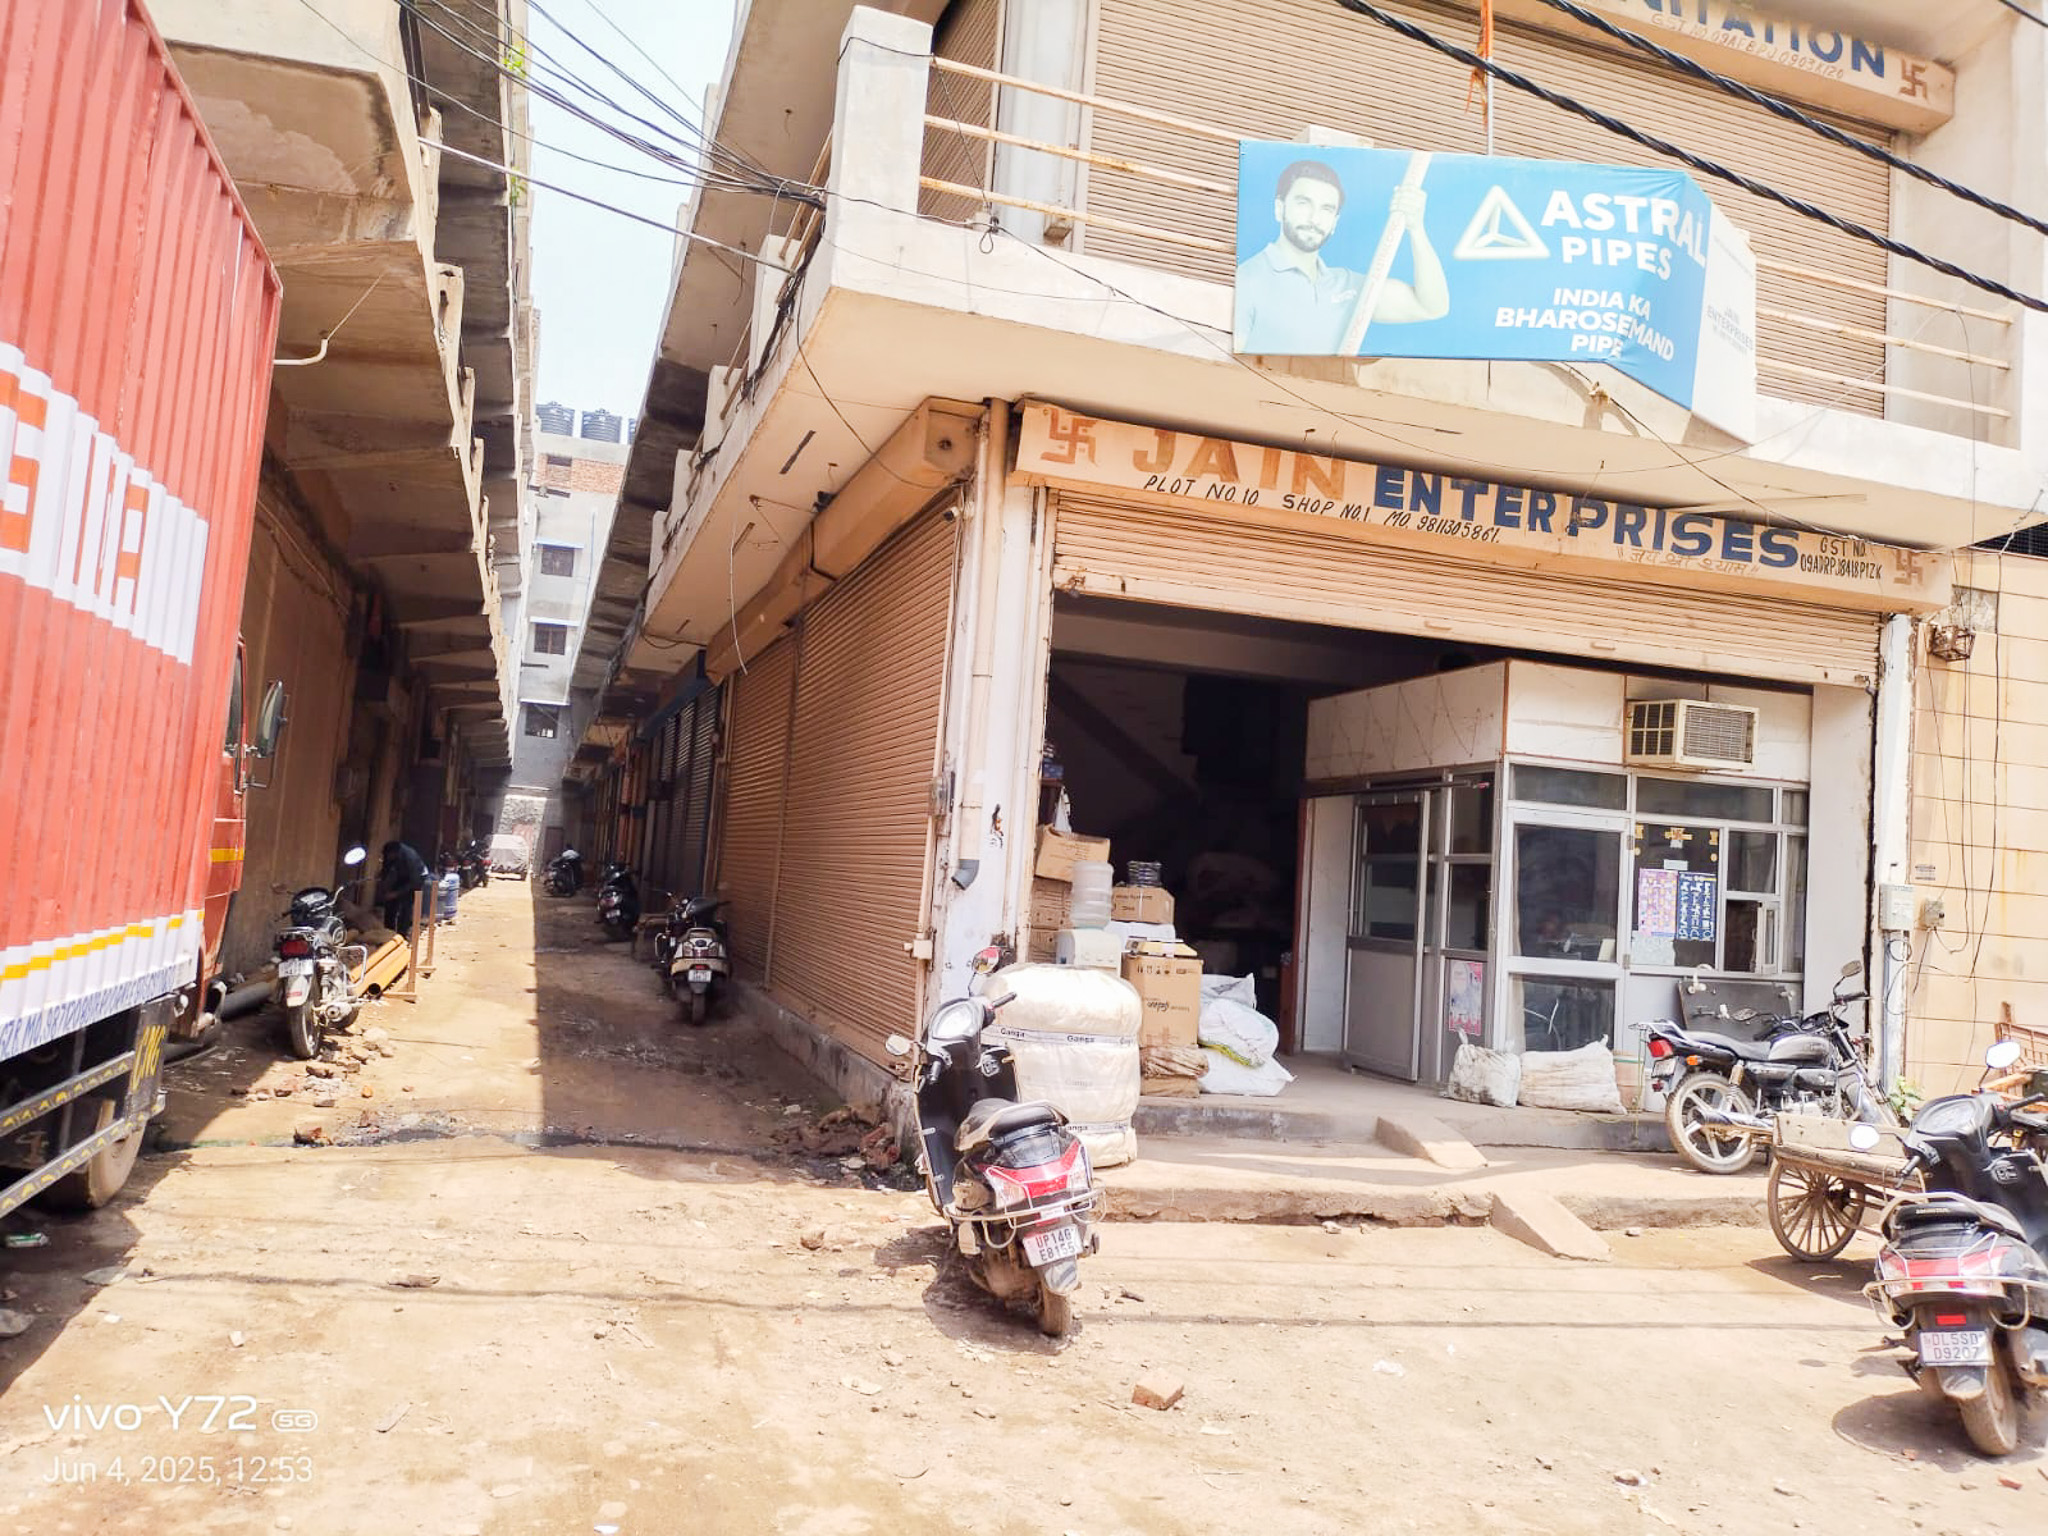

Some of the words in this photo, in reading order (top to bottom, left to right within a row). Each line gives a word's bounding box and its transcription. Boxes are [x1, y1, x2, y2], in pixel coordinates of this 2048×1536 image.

[1541, 189, 1707, 269] ASTRAL
[1562, 236, 1673, 281] PIPES
[1553, 287, 1624, 309] INDIA
[1628, 294, 1652, 322] KA
[1494, 306, 1675, 362] BHAROSEMAND
[1132, 428, 1346, 501] JAIN
[1373, 464, 1800, 568] ENTERPRISES
[1143, 475, 1197, 495] PLOT
[1282, 493, 1335, 514] SHOP
[1820, 536, 1848, 557] GST
[1066, 1034, 1096, 1044] Ganga
[1035, 1228, 1072, 1249] UP14G
[1039, 1240, 1077, 1261] E8155
[1931, 1332, 1979, 1346] DL5SD
